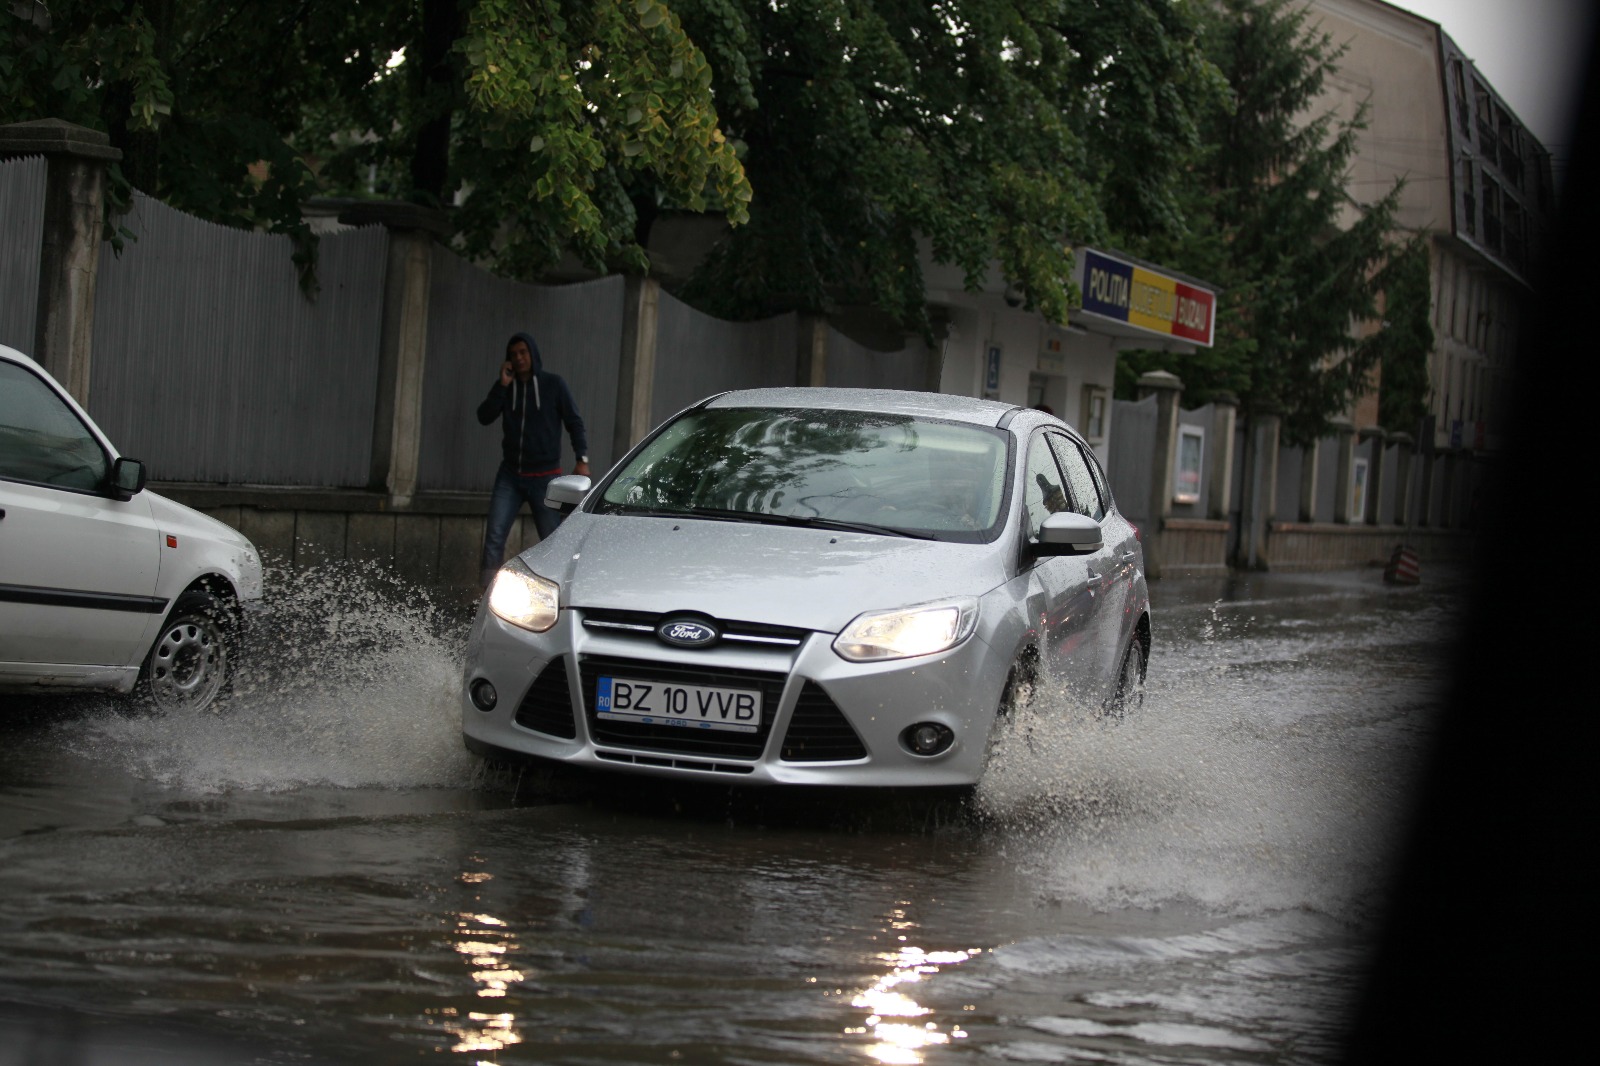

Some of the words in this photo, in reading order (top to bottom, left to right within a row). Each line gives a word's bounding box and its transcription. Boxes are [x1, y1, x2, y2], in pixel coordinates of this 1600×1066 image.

[1089, 267, 1129, 309] POLITIA
[670, 624, 702, 639] Ford
[598, 695, 610, 707] RO
[613, 682, 653, 711] BZ
[663, 687, 688, 714] 10
[696, 690, 755, 720] VVB
[665, 719, 687, 727] FORD
